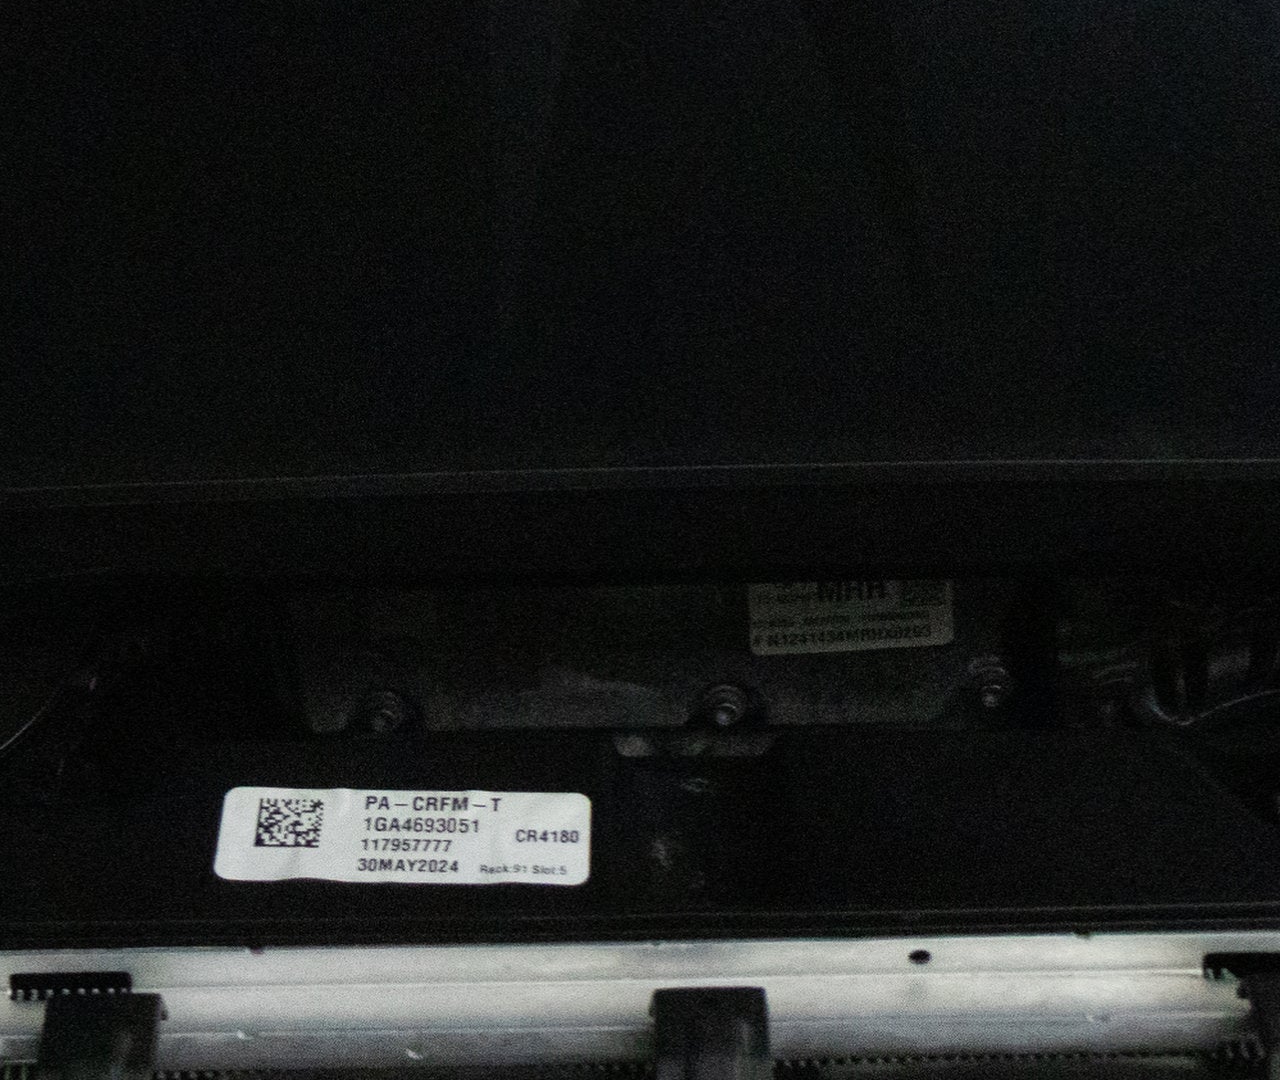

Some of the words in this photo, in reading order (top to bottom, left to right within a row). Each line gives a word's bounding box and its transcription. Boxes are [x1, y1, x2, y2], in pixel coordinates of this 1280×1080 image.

[364, 817, 480, 834] 1GA4693051
[514, 829, 581, 844] CR4180
[361, 837, 453, 853] 117957777
[356, 857, 460, 874] 30MAY2024
